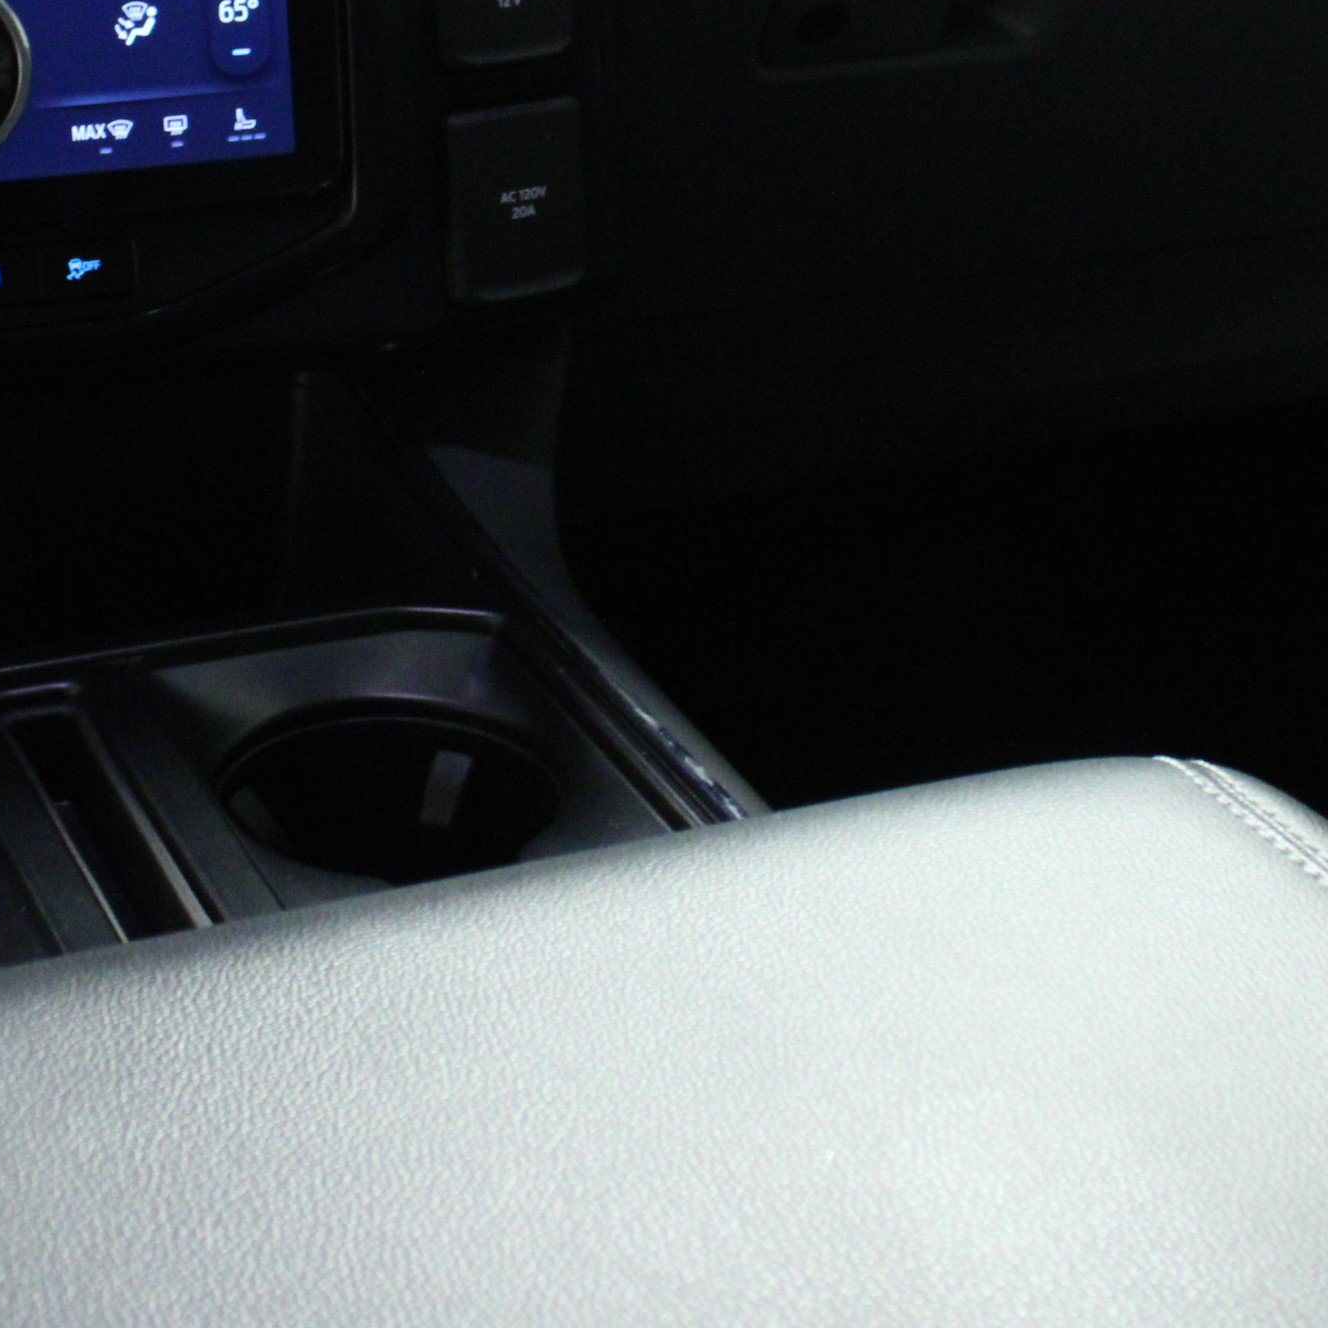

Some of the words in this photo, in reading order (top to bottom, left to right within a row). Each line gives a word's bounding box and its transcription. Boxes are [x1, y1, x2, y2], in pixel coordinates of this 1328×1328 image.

[72, 121, 108, 142] MAX
[500, 190, 516, 204] AC
[518, 185, 547, 202] 120V
